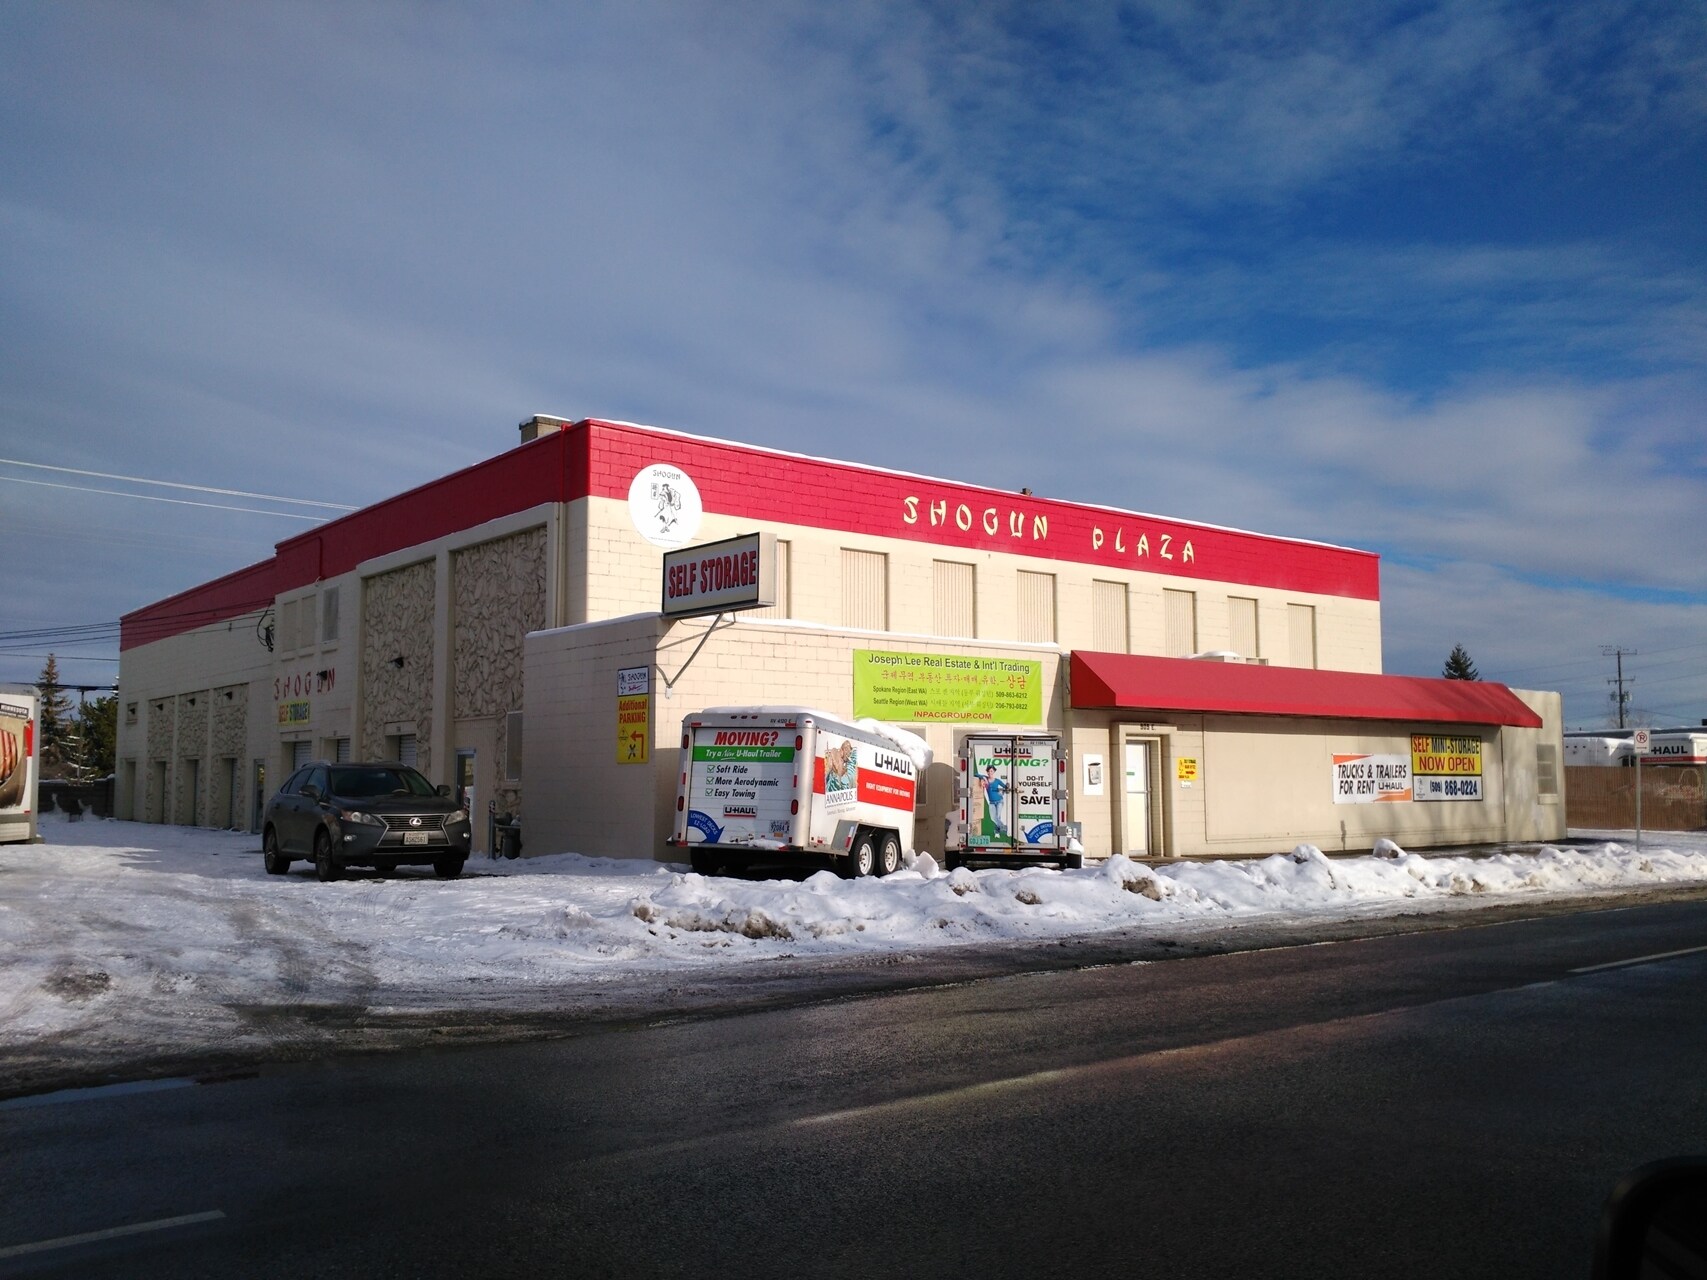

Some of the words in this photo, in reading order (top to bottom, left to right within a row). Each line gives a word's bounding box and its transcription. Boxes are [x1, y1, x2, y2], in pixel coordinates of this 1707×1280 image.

[652, 470, 680, 480] SHOGUN
[903, 496, 1048, 540] SHOGUN
[1092, 525, 1195, 564] PLAZA
[668, 562, 696, 598] SELF
[700, 550, 757, 594] STORAGE
[868, 654, 902, 666] Joseph
[905, 656, 922, 666] Lee
[924, 656, 942, 666] Real
[945, 658, 971, 668] Estate
[974, 660, 980, 669] &
[982, 660, 997, 670] Int'l
[1000, 662, 1030, 674] Trading
[1006, 674, 1026, 690] 상담
[872, 686, 891, 694] Spokane
[892, 686, 906, 694] Region
[889, 698, 904, 706] Region
[619, 712, 646, 724] PARKING
[914, 711, 992, 719] INPACGROUP.COM
[714, 731, 778, 746] MOVING?
[1413, 736, 1429, 752] SELF
[1432, 737, 1479, 754] MINI-STORAGE
[706, 750, 716, 758] Try
[760, 750, 781, 758] Trailer
[1651, 746, 1688, 754] -HAUL
[716, 765, 730, 773] Soft
[875, 752, 912, 776] U-HAUL
[1338, 764, 1364, 778] TRUCKS
[1367, 764, 1372, 778] &
[1376, 765, 1406, 778] TRAILERS
[1420, 757, 1445, 771] NOW
[1448, 757, 1475, 771] OPEN
[715, 777, 733, 785] More
[734, 777, 779, 788] Aerodynamic
[1339, 780, 1353, 794] FOR
[1357, 780, 1375, 794] RENT
[1430, 780, 1442, 793] (509)
[1445, 780, 1477, 796] 868-0224
[714, 789, 730, 797] Easy
[732, 789, 756, 799] Towing
[826, 790, 853, 804] ANNAPOLIS
[1021, 796, 1050, 805] SAVE
